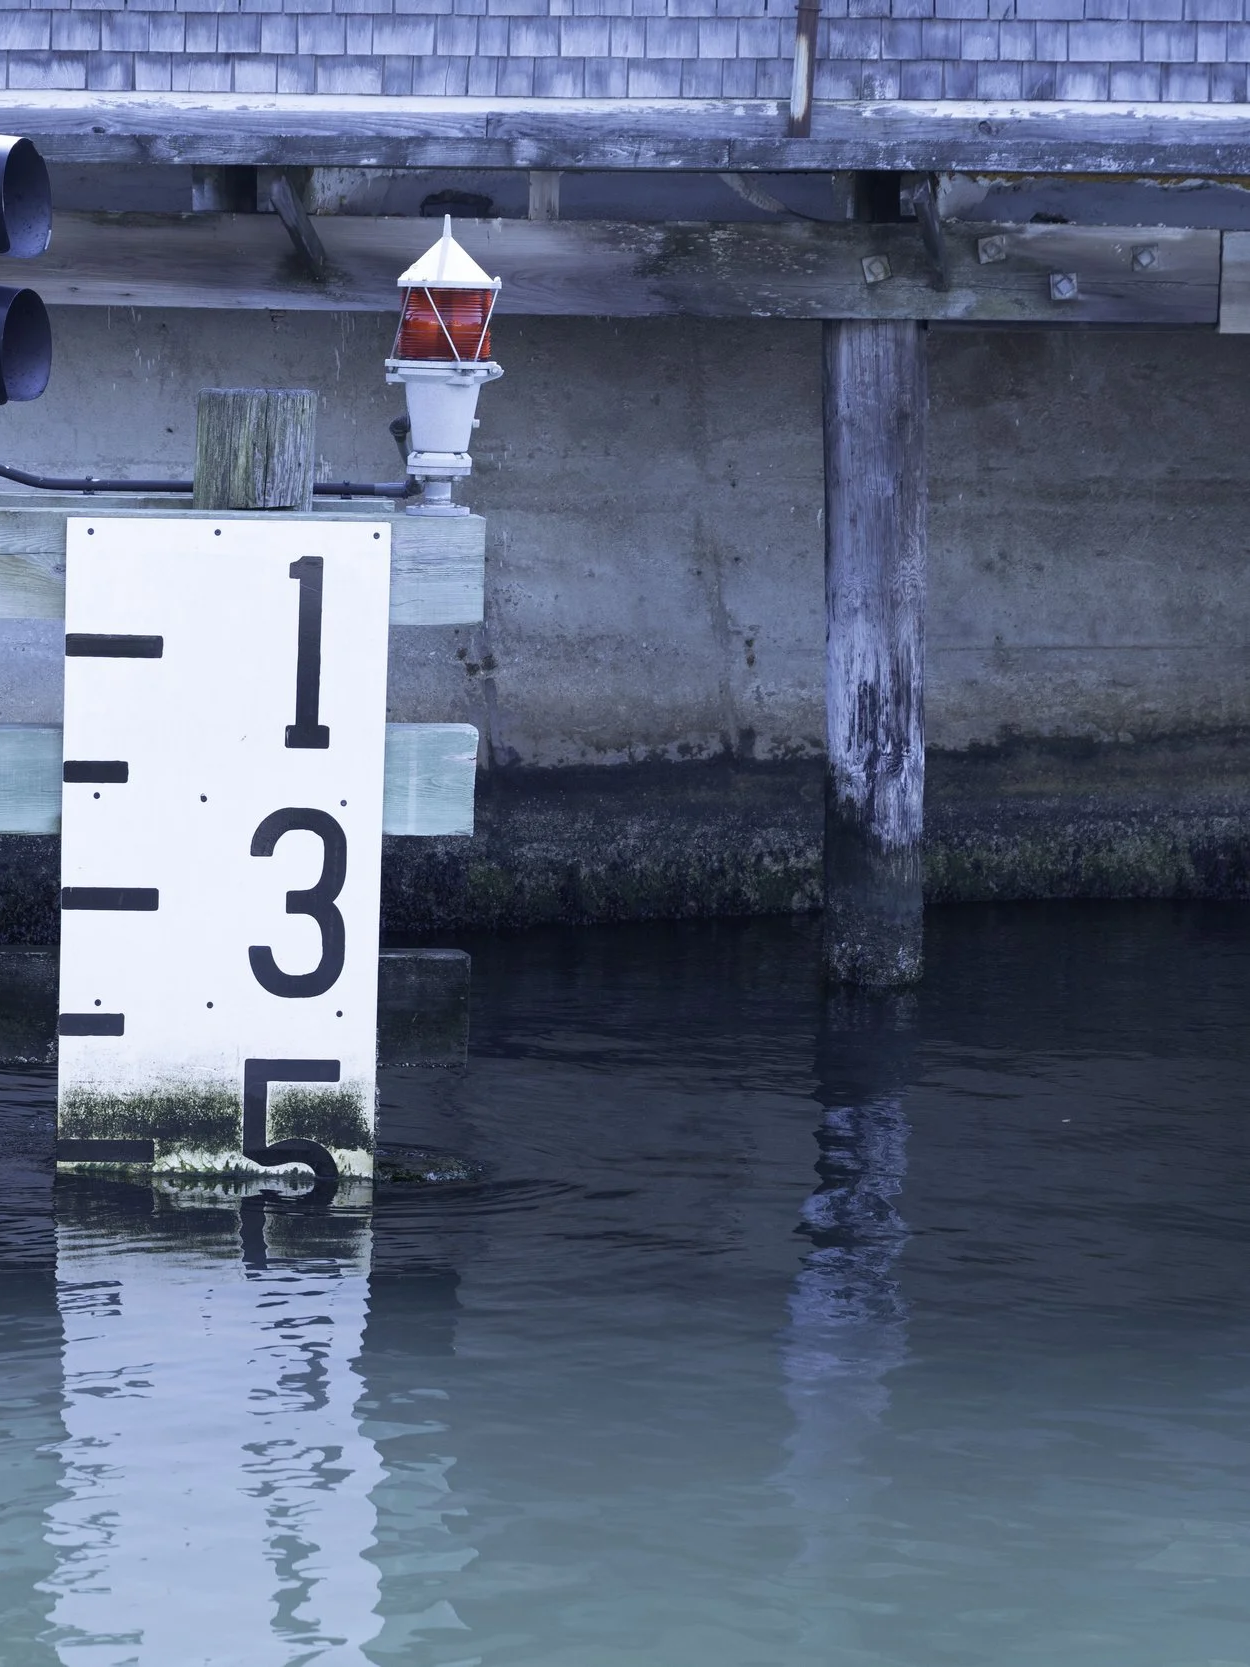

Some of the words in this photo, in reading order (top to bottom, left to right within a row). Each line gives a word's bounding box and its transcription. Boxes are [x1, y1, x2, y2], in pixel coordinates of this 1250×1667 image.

[285, 556, 330, 749] 1
[248, 807, 347, 998] 3
[242, 1058, 341, 1180] 5
